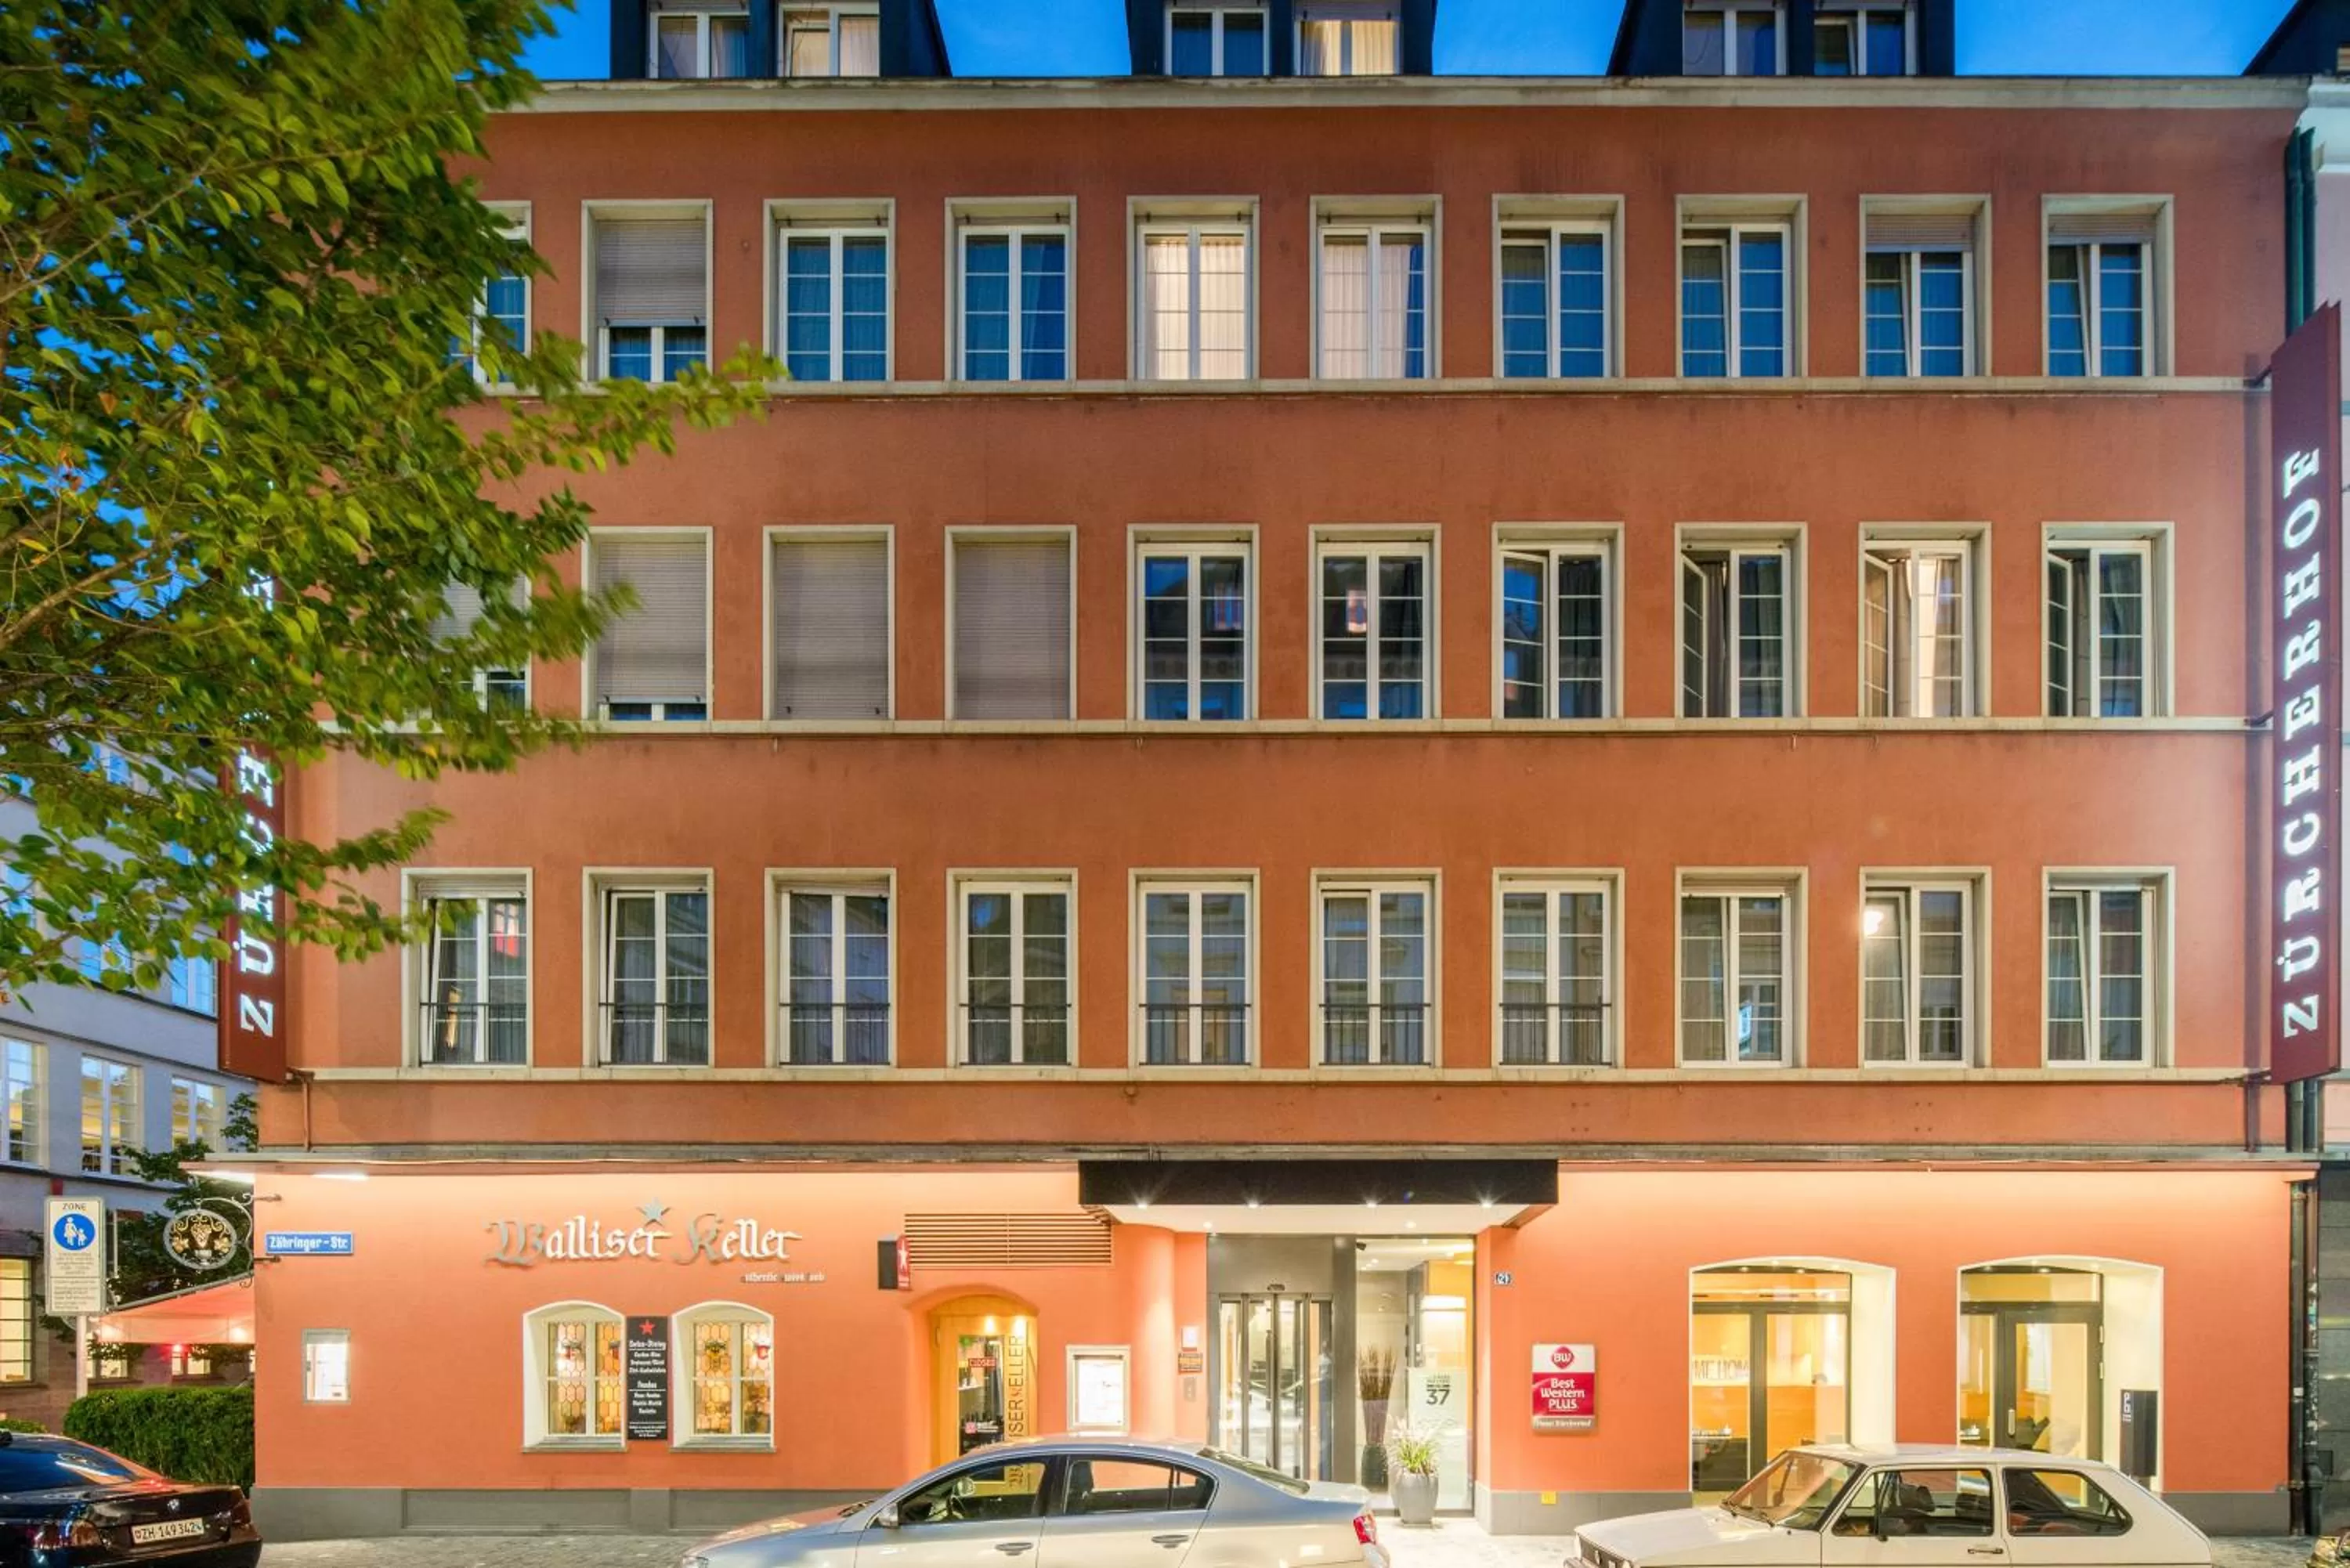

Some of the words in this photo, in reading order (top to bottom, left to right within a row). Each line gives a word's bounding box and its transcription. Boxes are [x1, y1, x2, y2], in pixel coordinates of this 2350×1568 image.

[2277, 447, 2321, 1039] ZÜRCHERHOF
[63, 1202, 87, 1211] ZONE
[483, 1215, 672, 1269] Walliser
[674, 1213, 802, 1265] Keller
[1553, 1353, 1572, 1363] BW
[1551, 1378, 1574, 1389] Best
[1426, 1389, 1450, 1404] 37
[1540, 1388, 1585, 1398] Western
[1549, 1398, 1577, 1409] PLUS
[141, 1526, 155, 1540] ZH
